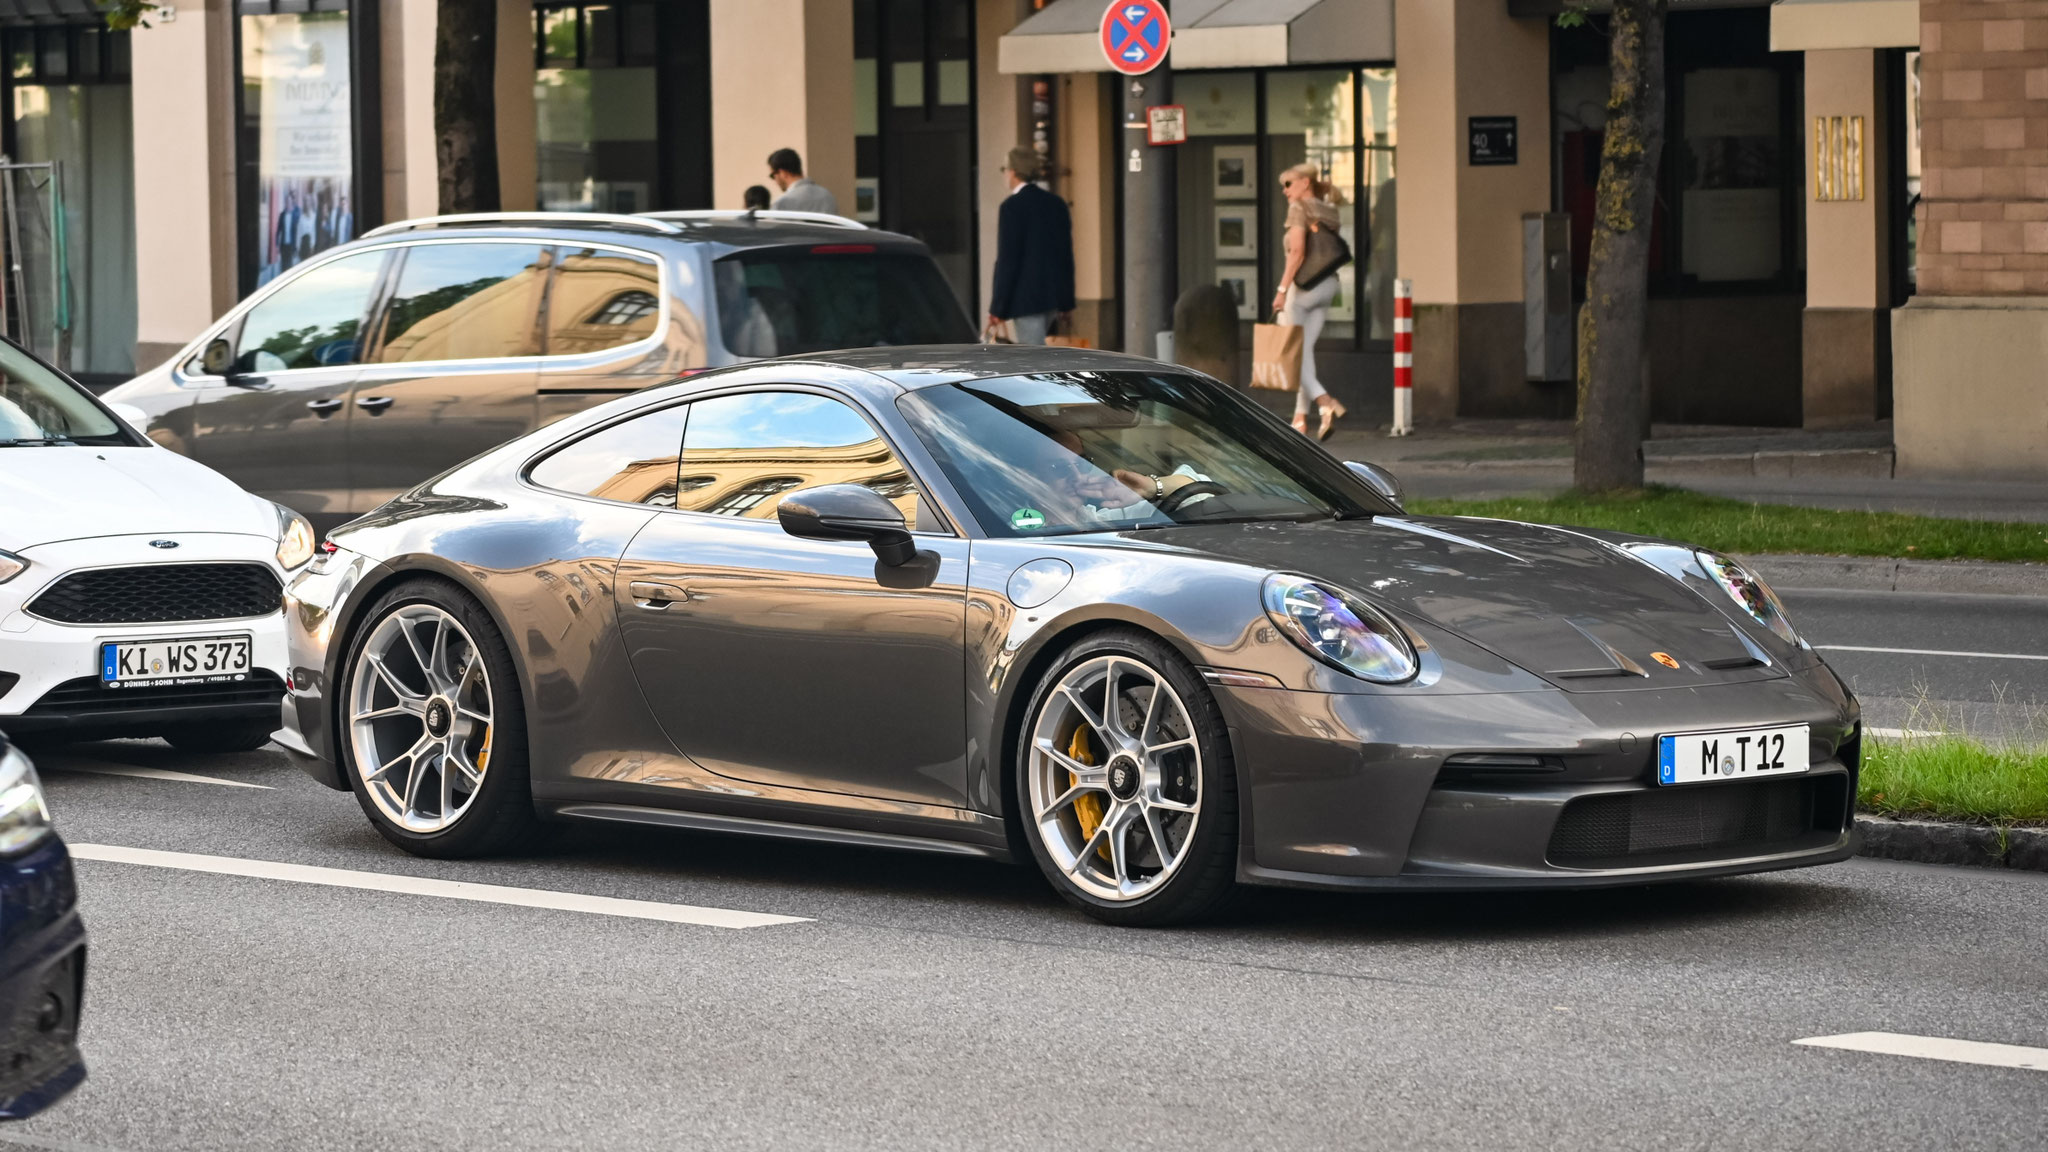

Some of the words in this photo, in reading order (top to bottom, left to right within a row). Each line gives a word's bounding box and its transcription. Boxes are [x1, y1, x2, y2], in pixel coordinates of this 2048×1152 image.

[1472, 133, 1488, 148] 40
[1022, 509, 1033, 519] 4
[119, 648, 149, 676] KI
[167, 645, 198, 673] WS
[204, 642, 247, 671] 373
[107, 666, 113, 675] D
[1702, 739, 1718, 775] M
[1736, 736, 1751, 772] T
[1757, 734, 1784, 771] 12
[1664, 765, 1671, 776] D
